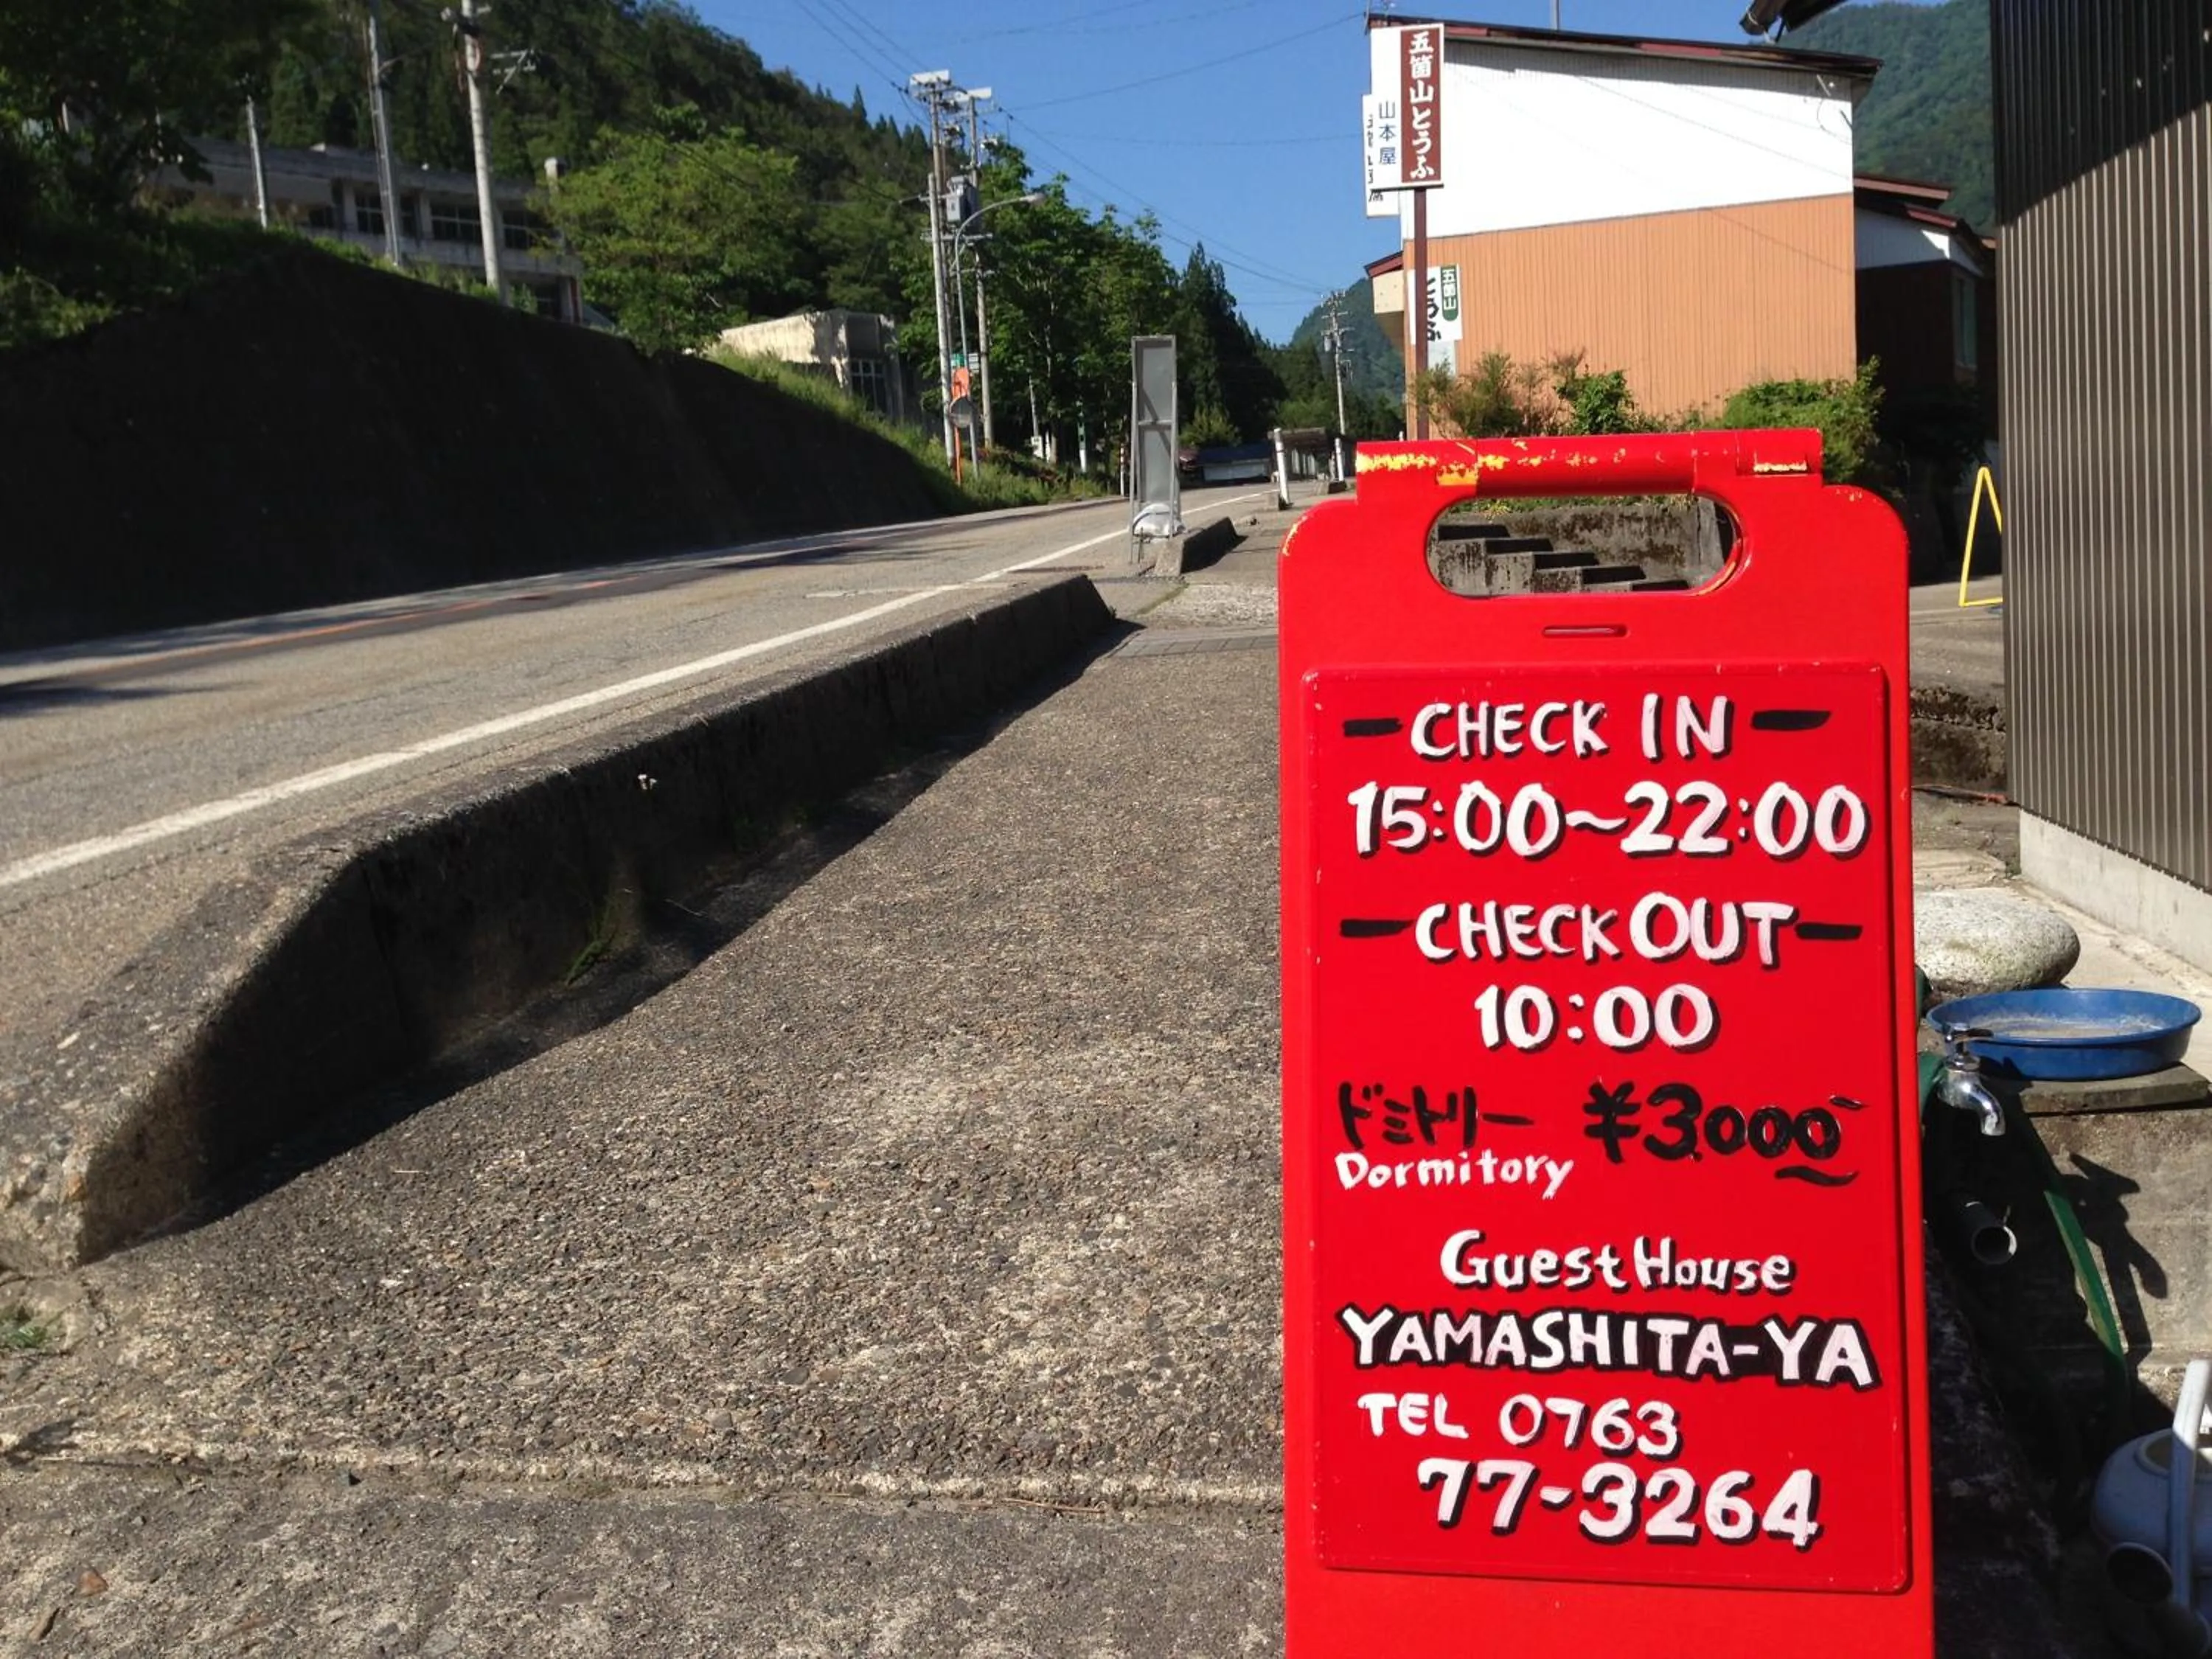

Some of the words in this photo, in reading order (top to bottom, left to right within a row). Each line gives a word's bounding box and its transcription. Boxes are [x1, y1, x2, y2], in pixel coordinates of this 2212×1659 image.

[1378, 100, 1397, 165] 山本屋
[1409, 31, 1435, 179] 五箇山とうふ
[1411, 700, 1610, 761] CHECK
[1641, 693, 1734, 761] IN
[1415, 899, 1622, 962] CHECK
[1629, 891, 1799, 971] OUT
[1475, 981, 1721, 1054] 10:00
[1338, 1080, 1535, 1150] ドミトリー
[1335, 1148, 1575, 1200] Dormitory
[1440, 1228, 1629, 1292] Guest
[1633, 1235, 1798, 1294] House
[1338, 1305, 1877, 1389] YAMASHITA-YA
[1357, 1391, 1470, 1440] TEL
[1498, 1391, 1682, 1461] 0763
[1416, 1456, 1824, 1548] 77-3264
